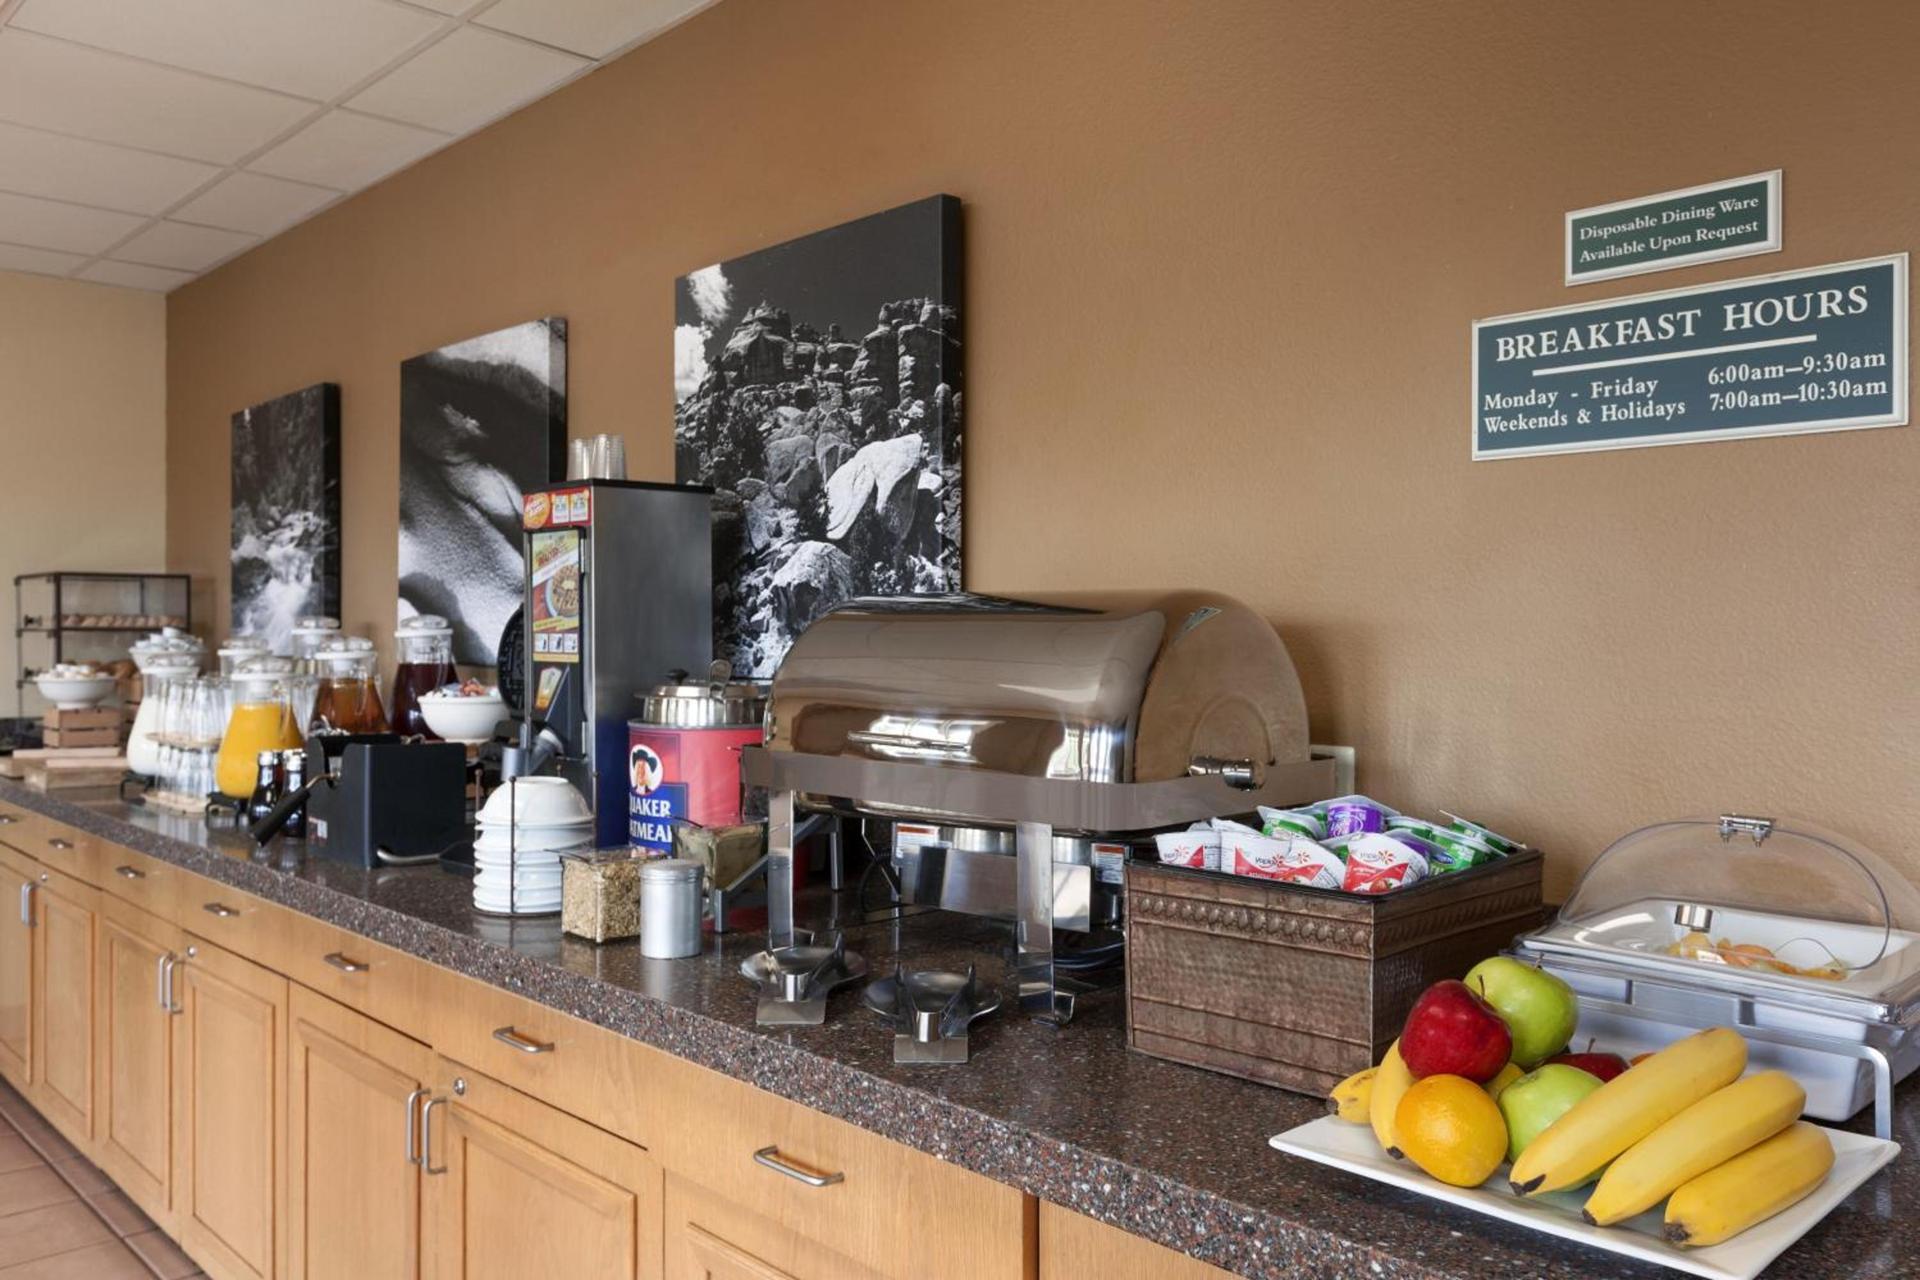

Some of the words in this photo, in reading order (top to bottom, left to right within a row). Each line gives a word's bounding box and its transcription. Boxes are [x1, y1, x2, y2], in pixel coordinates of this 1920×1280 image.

[1579, 215, 1658, 240] Disposable
[1661, 206, 1716, 225] Dining
[1718, 197, 1759, 213] Ware
[1579, 241, 1646, 263] Available
[1649, 234, 1692, 252] Upon
[1695, 221, 1759, 242] Request
[1495, 308, 1702, 362] BREAKFAST
[1723, 284, 1868, 332] HOURS
[1483, 388, 1559, 411] Monday
[1590, 376, 1659, 399] Friday
[1483, 412, 1568, 434] Weekends
[1576, 408, 1592, 425] &
[1600, 399, 1686, 423] Holidays
